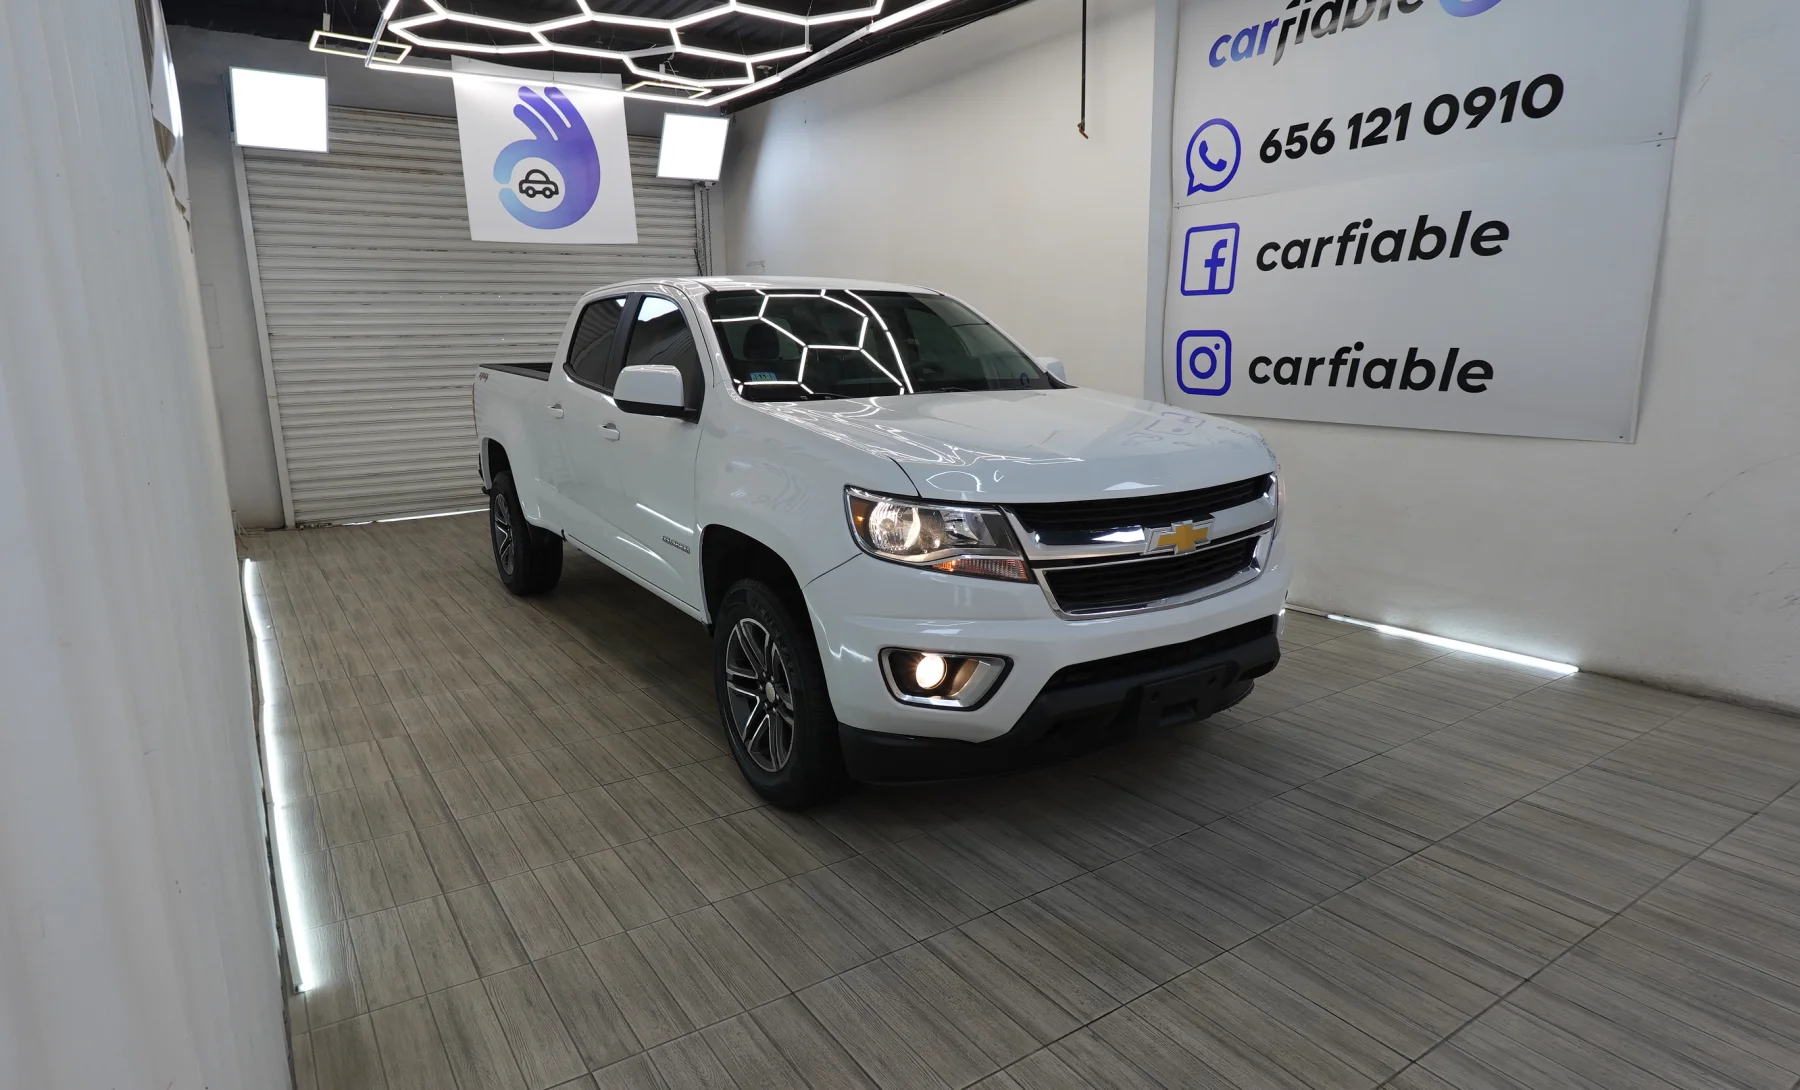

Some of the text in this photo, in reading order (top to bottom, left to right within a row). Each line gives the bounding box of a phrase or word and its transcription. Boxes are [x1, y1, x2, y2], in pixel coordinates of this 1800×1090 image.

[1259, 73, 1565, 164] 656 121 0910
[1256, 210, 1510, 272] carfiable
[1248, 341, 1494, 394] carfiable
